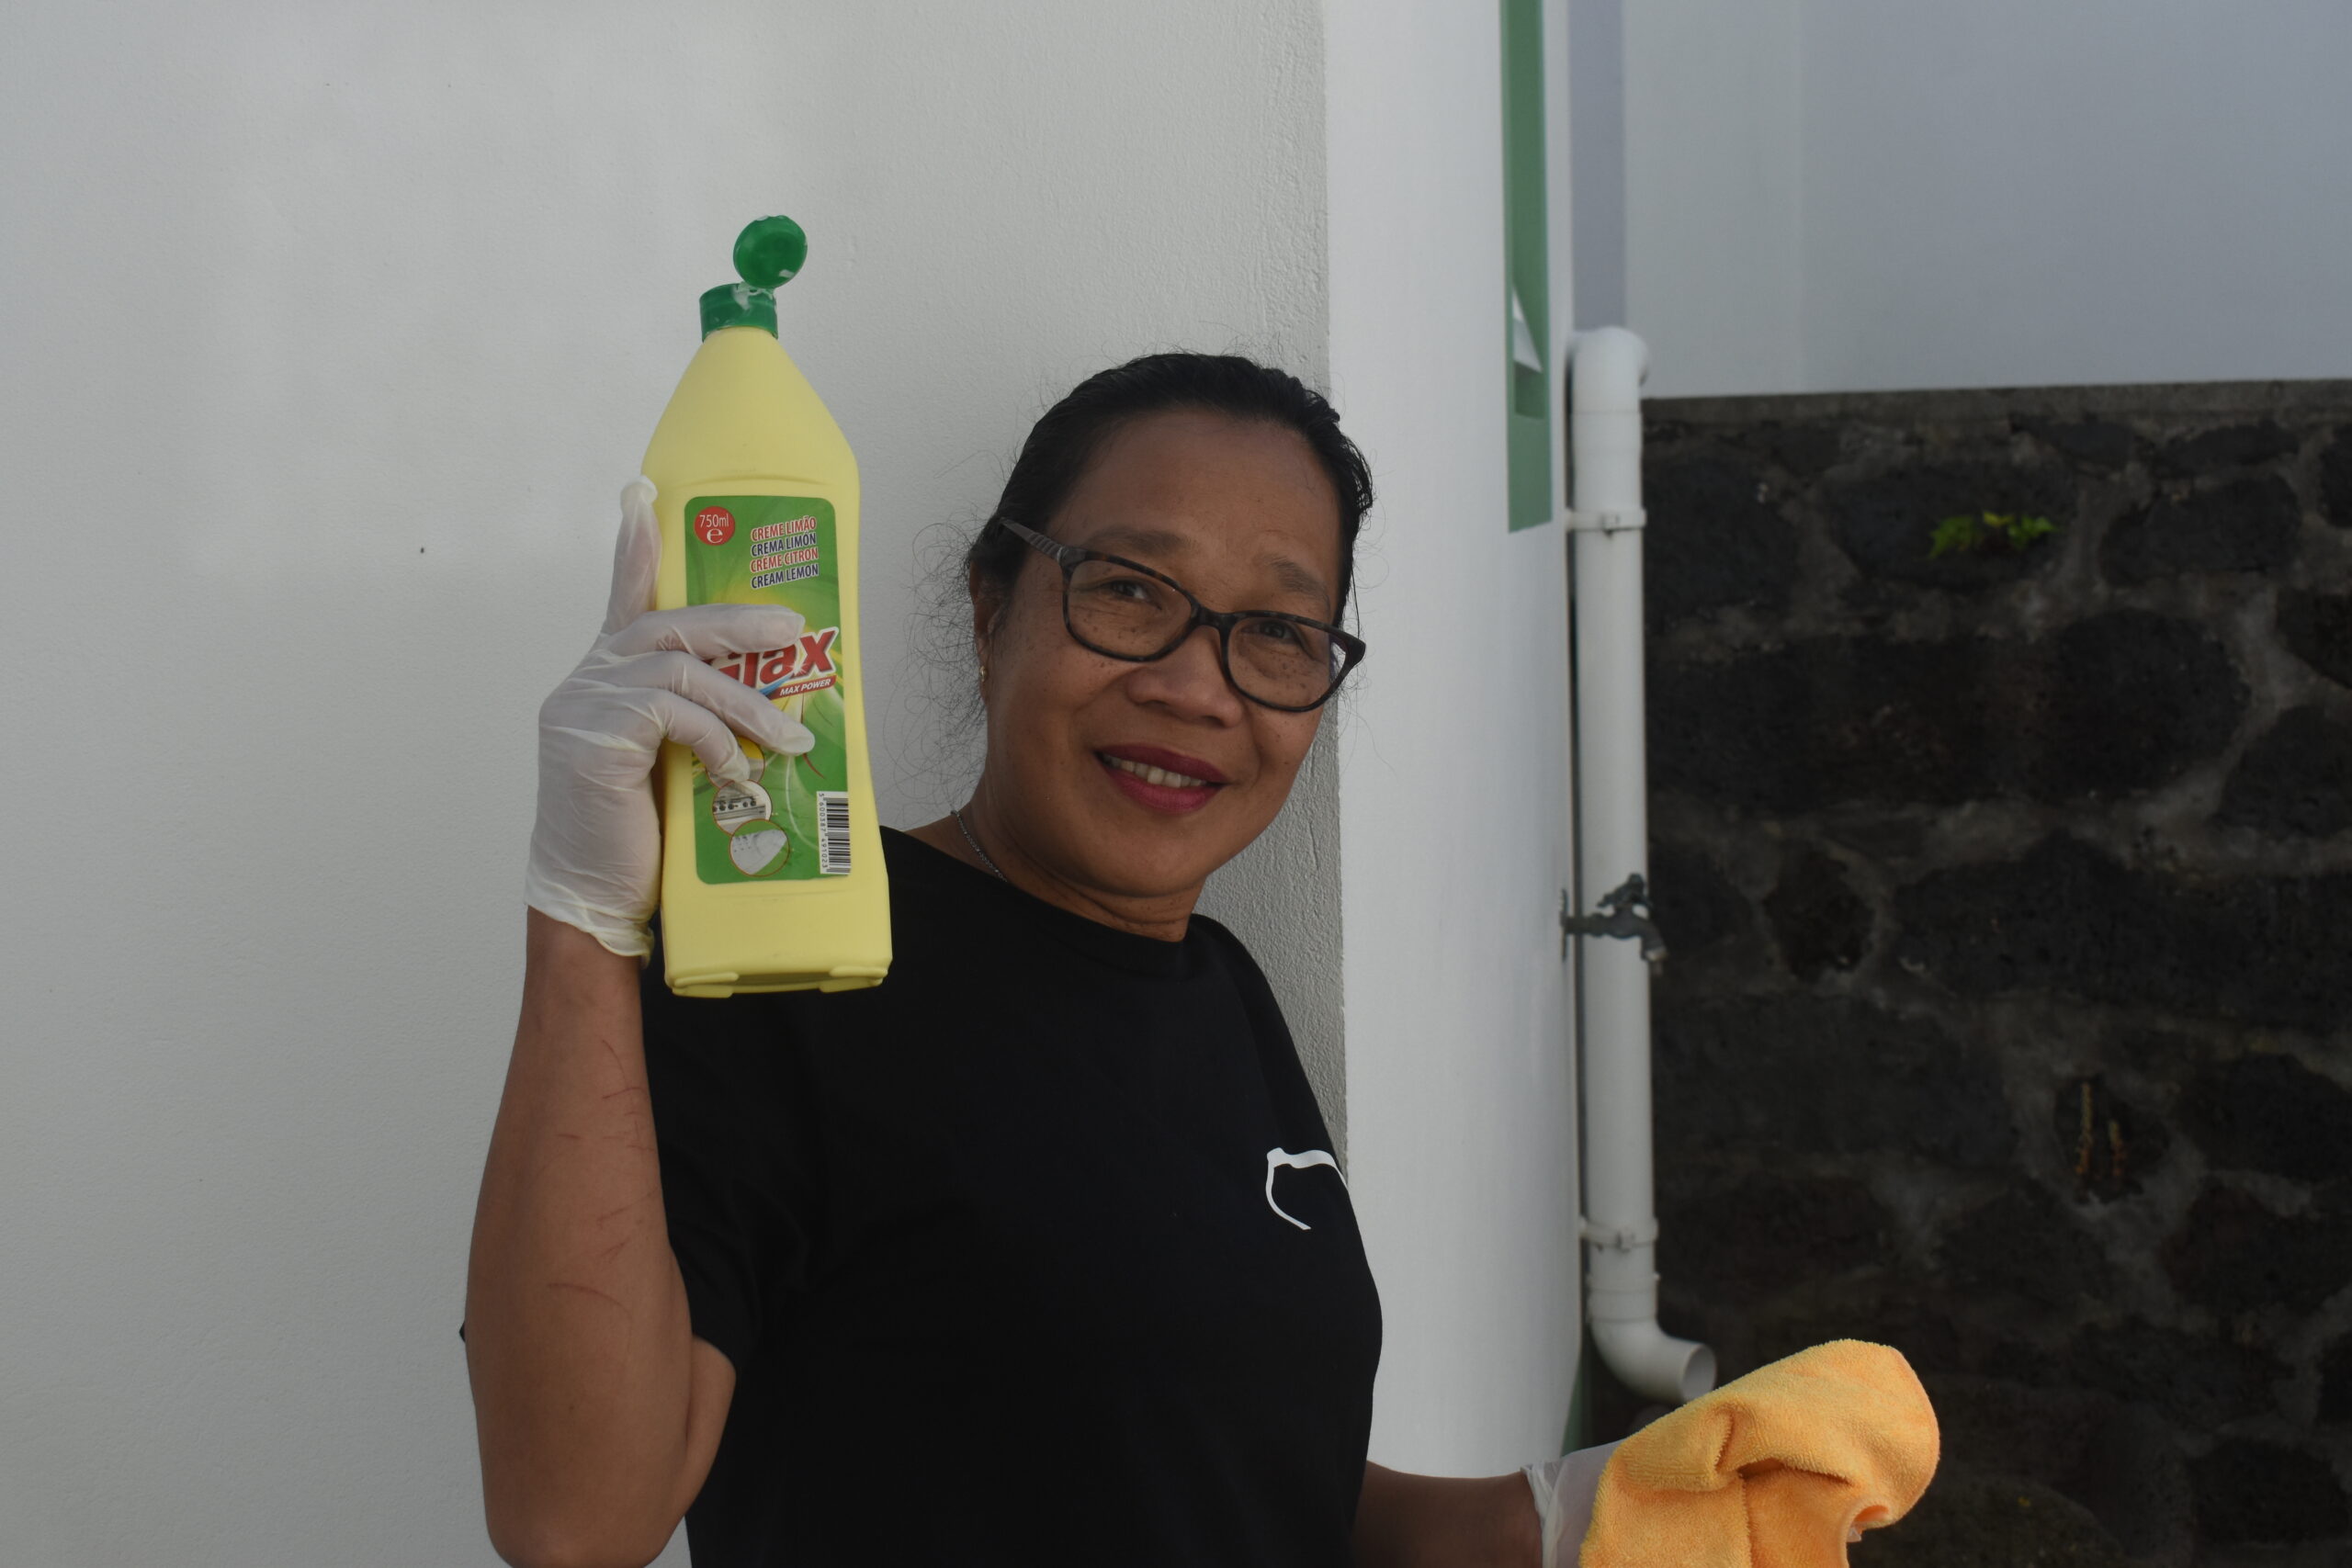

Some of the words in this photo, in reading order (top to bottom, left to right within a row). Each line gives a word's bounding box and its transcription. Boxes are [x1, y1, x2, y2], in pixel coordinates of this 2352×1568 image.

[699, 513, 729, 528] 750ml
[751, 523, 785, 542] CREME
[786, 515, 817, 535] LIMÃO
[751, 539, 784, 557] CREMA
[786, 532, 817, 550] LIMÓN
[784, 547, 819, 565] CITRON
[751, 570, 785, 589] CREAM
[786, 563, 820, 582] LEMON
[779, 686, 799, 696] MAX
[799, 678, 831, 692] POWER
